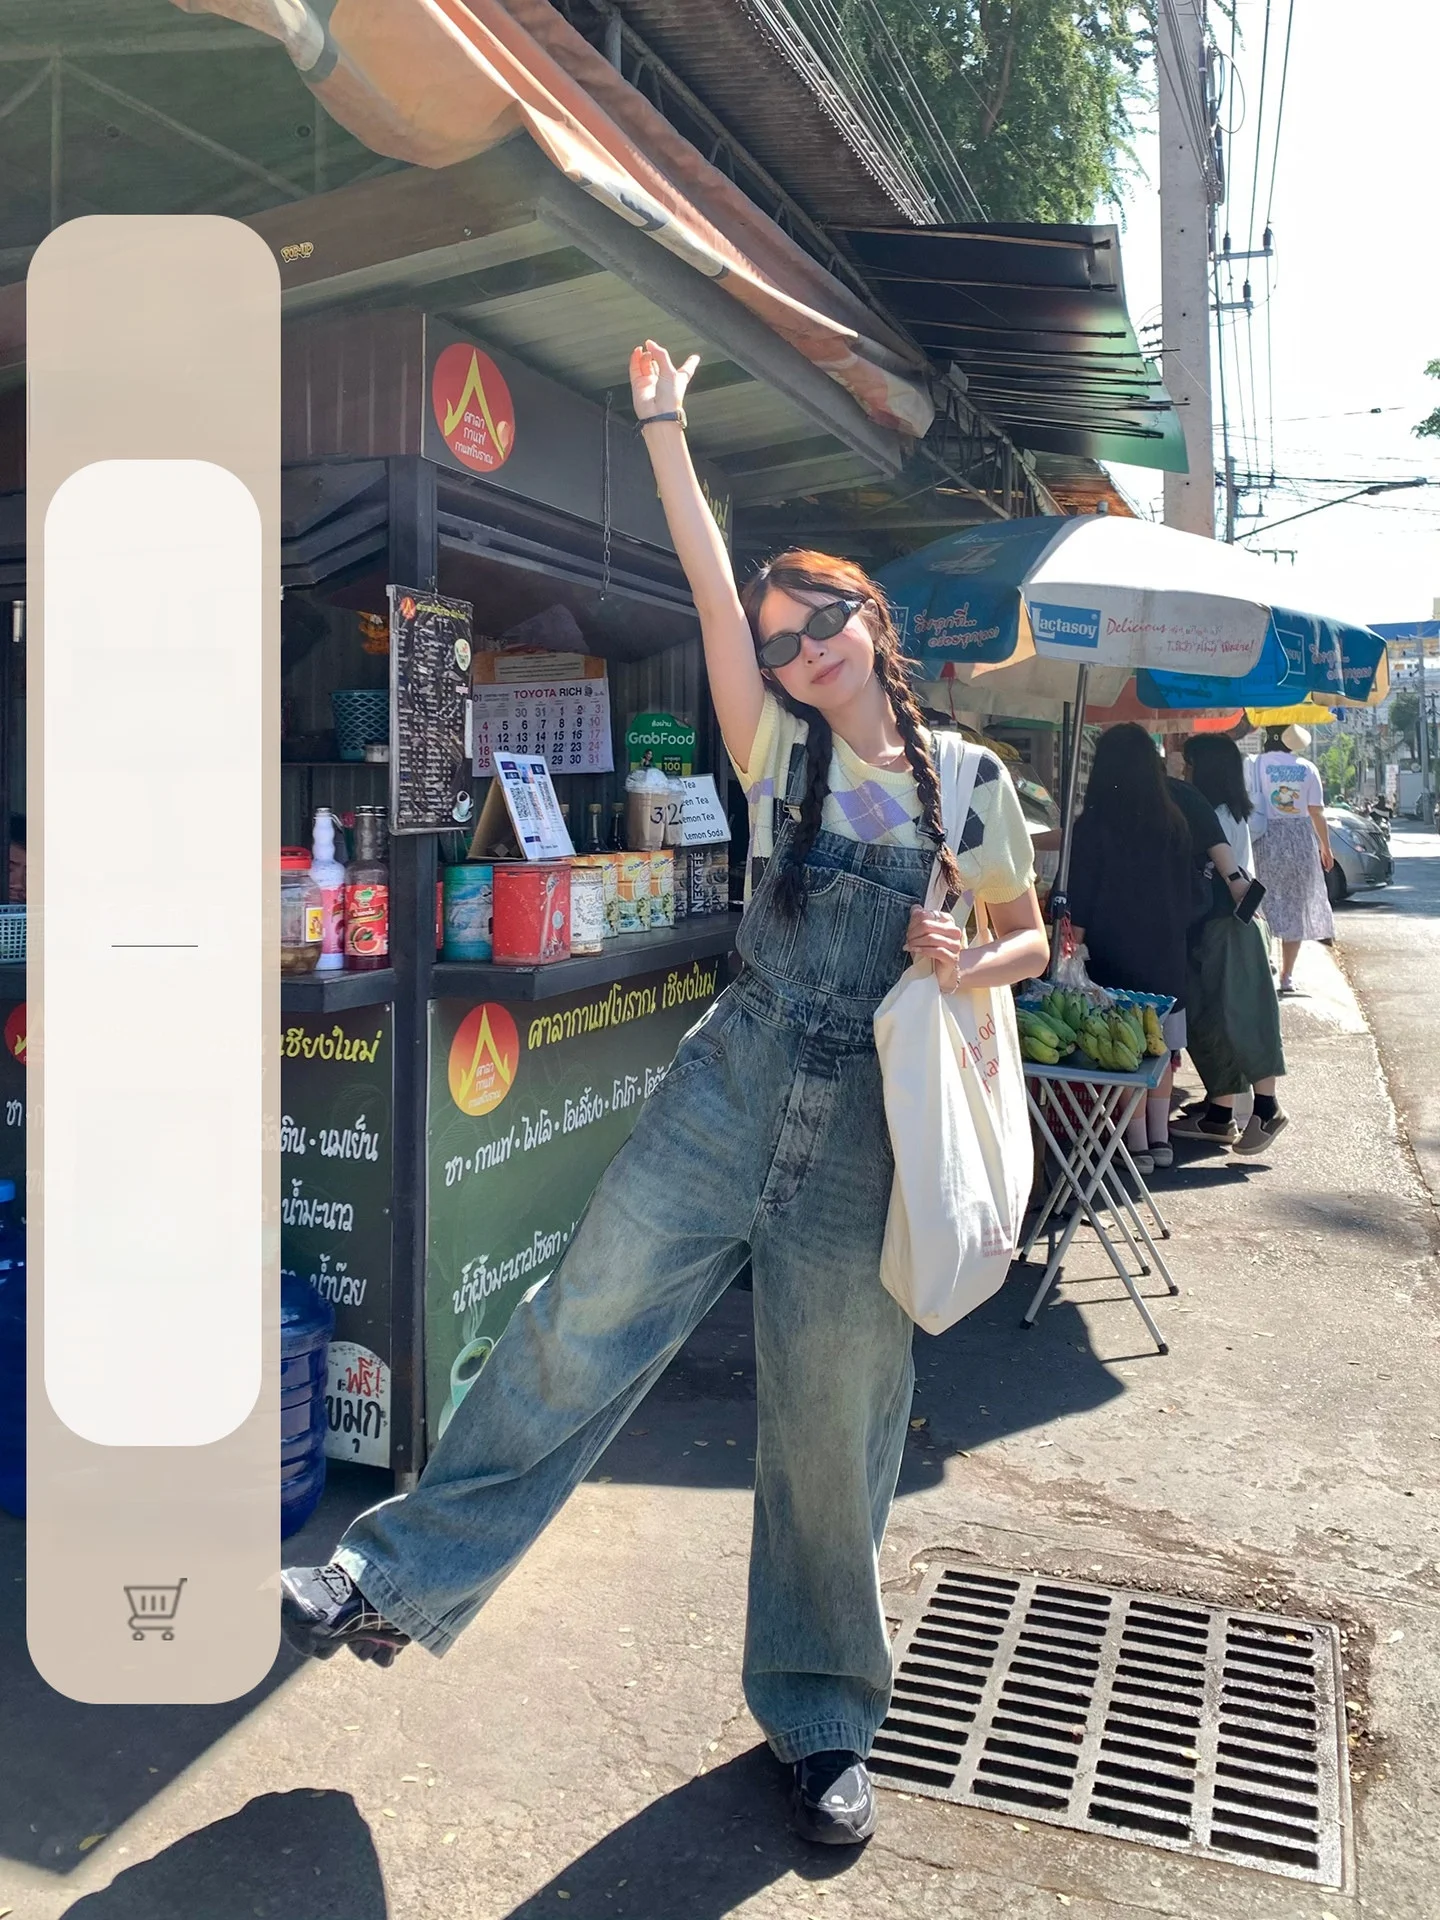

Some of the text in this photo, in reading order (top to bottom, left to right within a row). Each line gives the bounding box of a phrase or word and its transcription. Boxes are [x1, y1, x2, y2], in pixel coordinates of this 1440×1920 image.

[1031, 607, 1098, 640] Lactasoy
[1107, 618, 1166, 635] Delicious
[514, 689, 556, 700] TOYOTA
[559, 687, 582, 697] RICH
[515, 707, 528, 718] 30
[535, 706, 546, 718] 31
[482, 721, 489, 731] 4
[502, 721, 509, 731] 5
[521, 720, 528, 730] 6
[541, 719, 547, 729] 7
[559, 718, 565, 728] 8
[576, 717, 583, 727] 9
[479, 734, 488, 743] 11
[498, 733, 509, 743] 12
[516, 732, 528, 742] 13
[536, 732, 546, 741] 14
[554, 731, 564, 740] 15
[572, 730, 582, 740] 16
[628, 731, 696, 746] GrabFood
[479, 746, 490, 756] 18
[516, 744, 528, 754] 20
[535, 744, 545, 753] 21
[553, 743, 564, 753] 22
[571, 742, 582, 752] 23
[588, 741, 600, 751] 24
[479, 753, 600, 768] 25 29 30 31
[663, 762, 681, 771] 100
[683, 780, 696, 789] Tea
[682, 796, 710, 807] een Tea
[682, 812, 716, 824] emon Tea
[684, 828, 724, 841] Lemon Soda
[691, 851, 704, 913] NESCAFÉ
[662, 960, 718, 1009] เชียงใหม่
[7, 1100, 22, 1127] ชา
[319, 1114, 379, 1162] นมเย็น
[474, 1125, 514, 1174] กาแฟ
[522, 1109, 552, 1151] ไมโล
[281, 1178, 354, 1232] น้ำมะนาว
